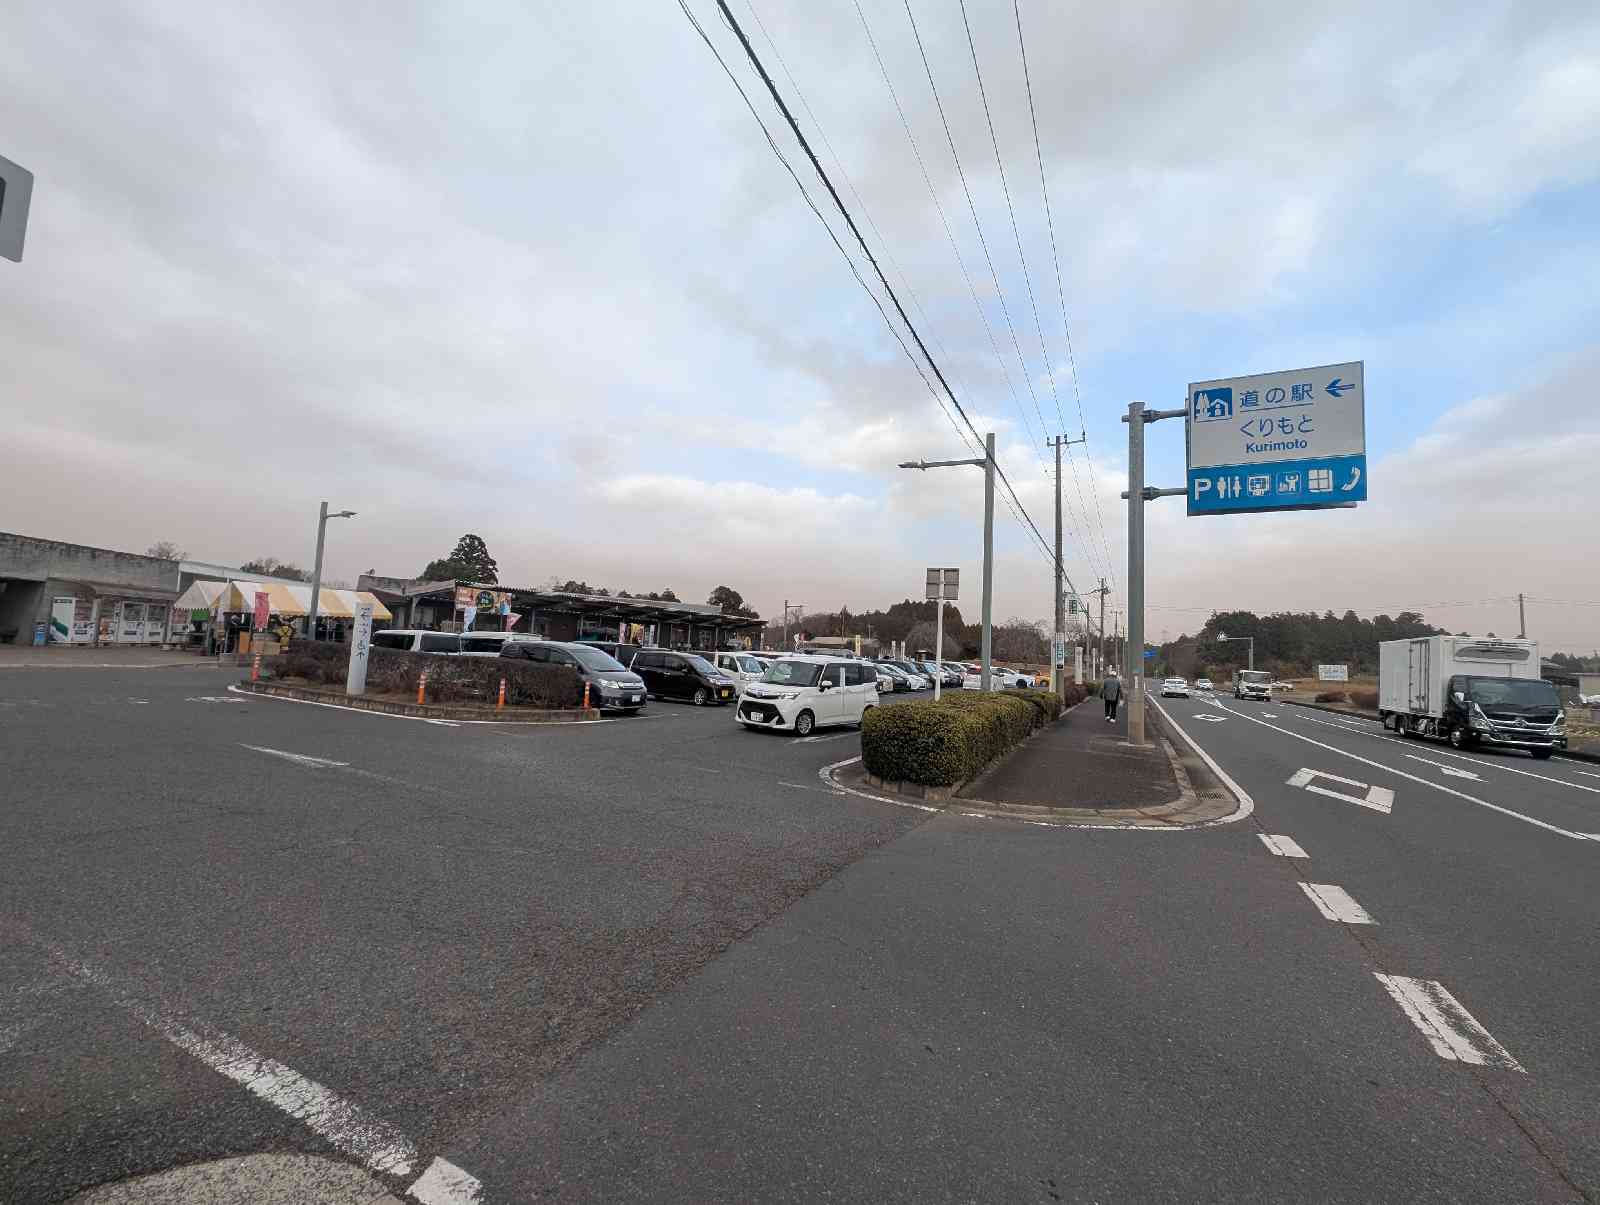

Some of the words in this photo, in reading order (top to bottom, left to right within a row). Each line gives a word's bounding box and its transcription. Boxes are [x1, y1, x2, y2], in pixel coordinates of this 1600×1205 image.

[1240, 383, 1313, 408] 道の駅
[1240, 414, 1315, 438] くりもと
[1246, 438, 1308, 454] Kurimoto
[1194, 478, 1212, 501] P
